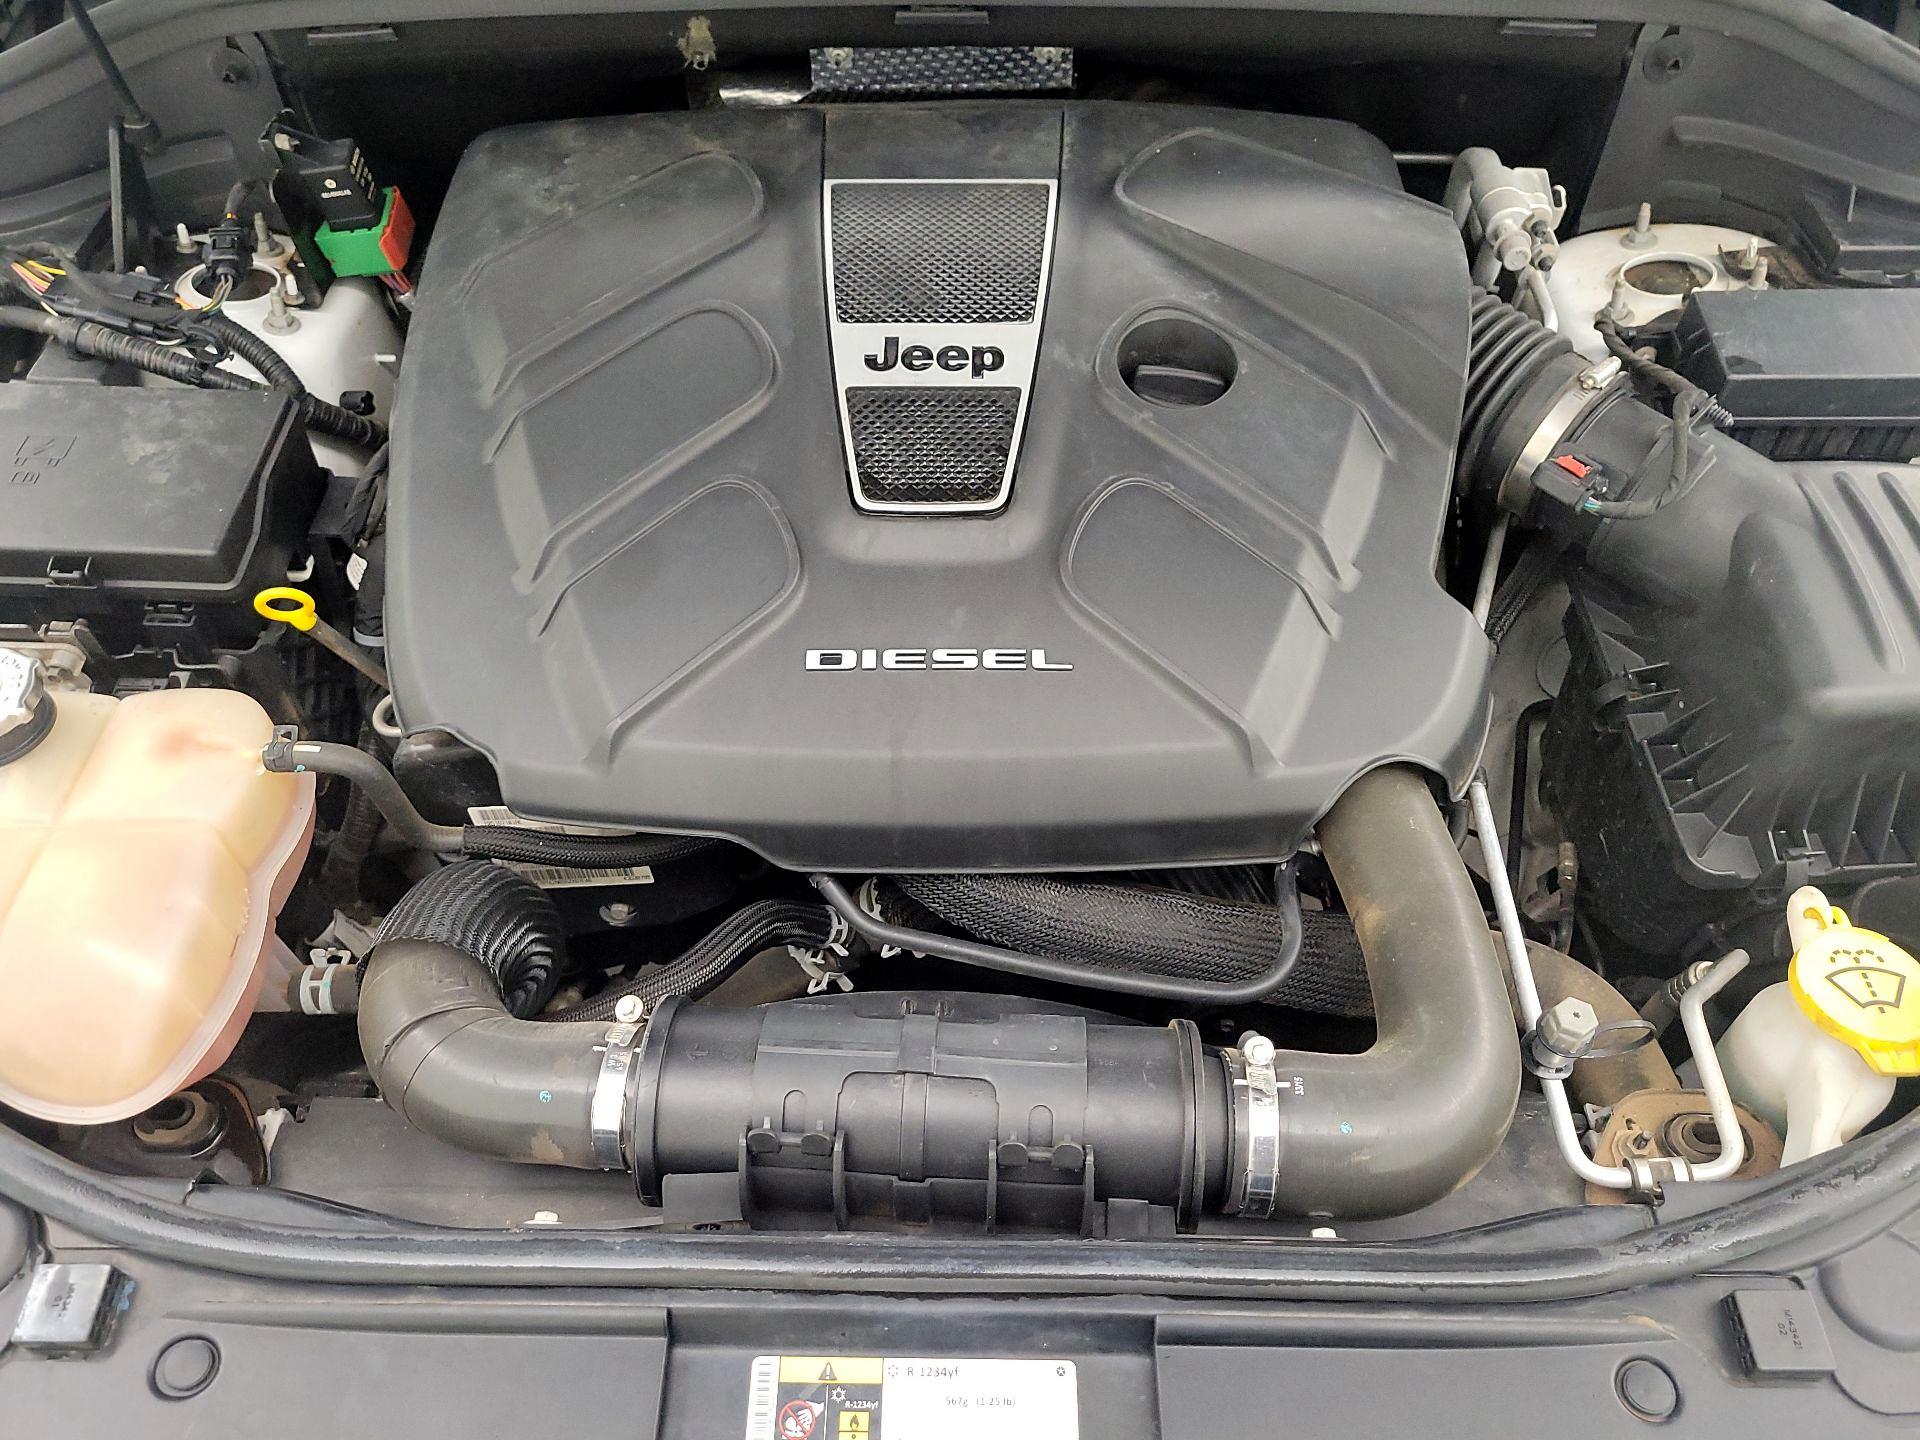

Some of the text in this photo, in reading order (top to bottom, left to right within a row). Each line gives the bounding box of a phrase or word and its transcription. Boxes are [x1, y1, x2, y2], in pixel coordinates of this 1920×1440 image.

[863, 336, 1005, 380] Jeep
[805, 648, 1074, 672] DIESEL
[845, 1400, 879, 1410] R-1234yf
